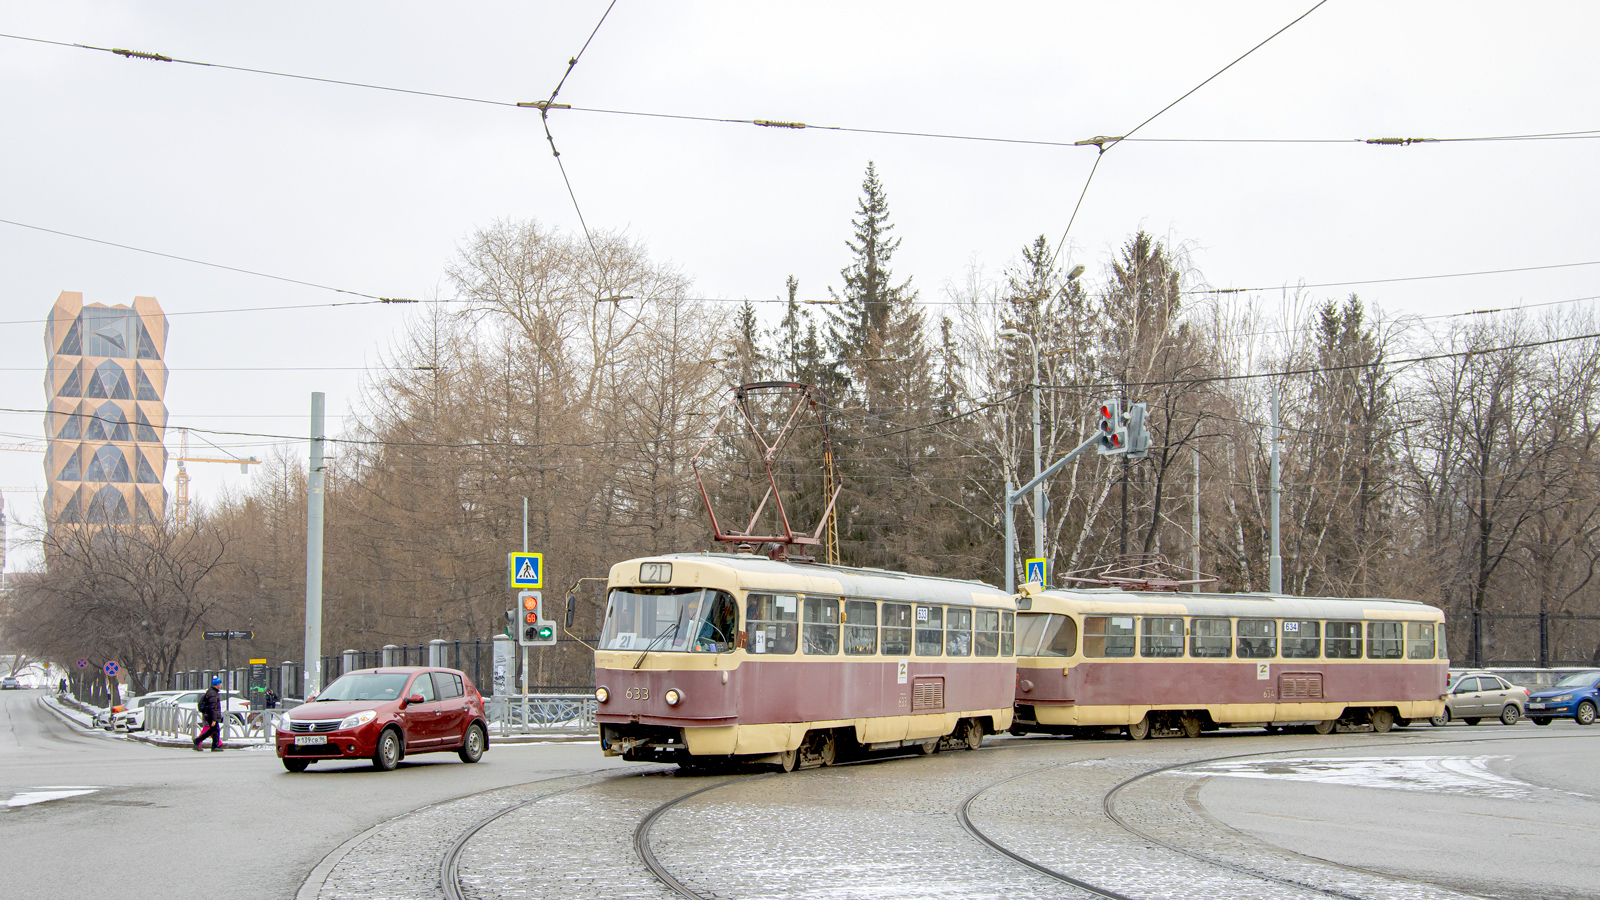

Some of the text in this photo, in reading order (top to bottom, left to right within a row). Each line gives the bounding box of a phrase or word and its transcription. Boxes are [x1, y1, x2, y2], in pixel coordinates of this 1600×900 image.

[649, 564, 663, 582] 21
[917, 608, 927, 619] 633
[1285, 622, 1297, 631] 634
[619, 635, 632, 648] 21
[757, 635, 764, 643] 21
[625, 687, 650, 700] 633
[1263, 690, 1275, 699] 634
[898, 696, 908, 708] 633
